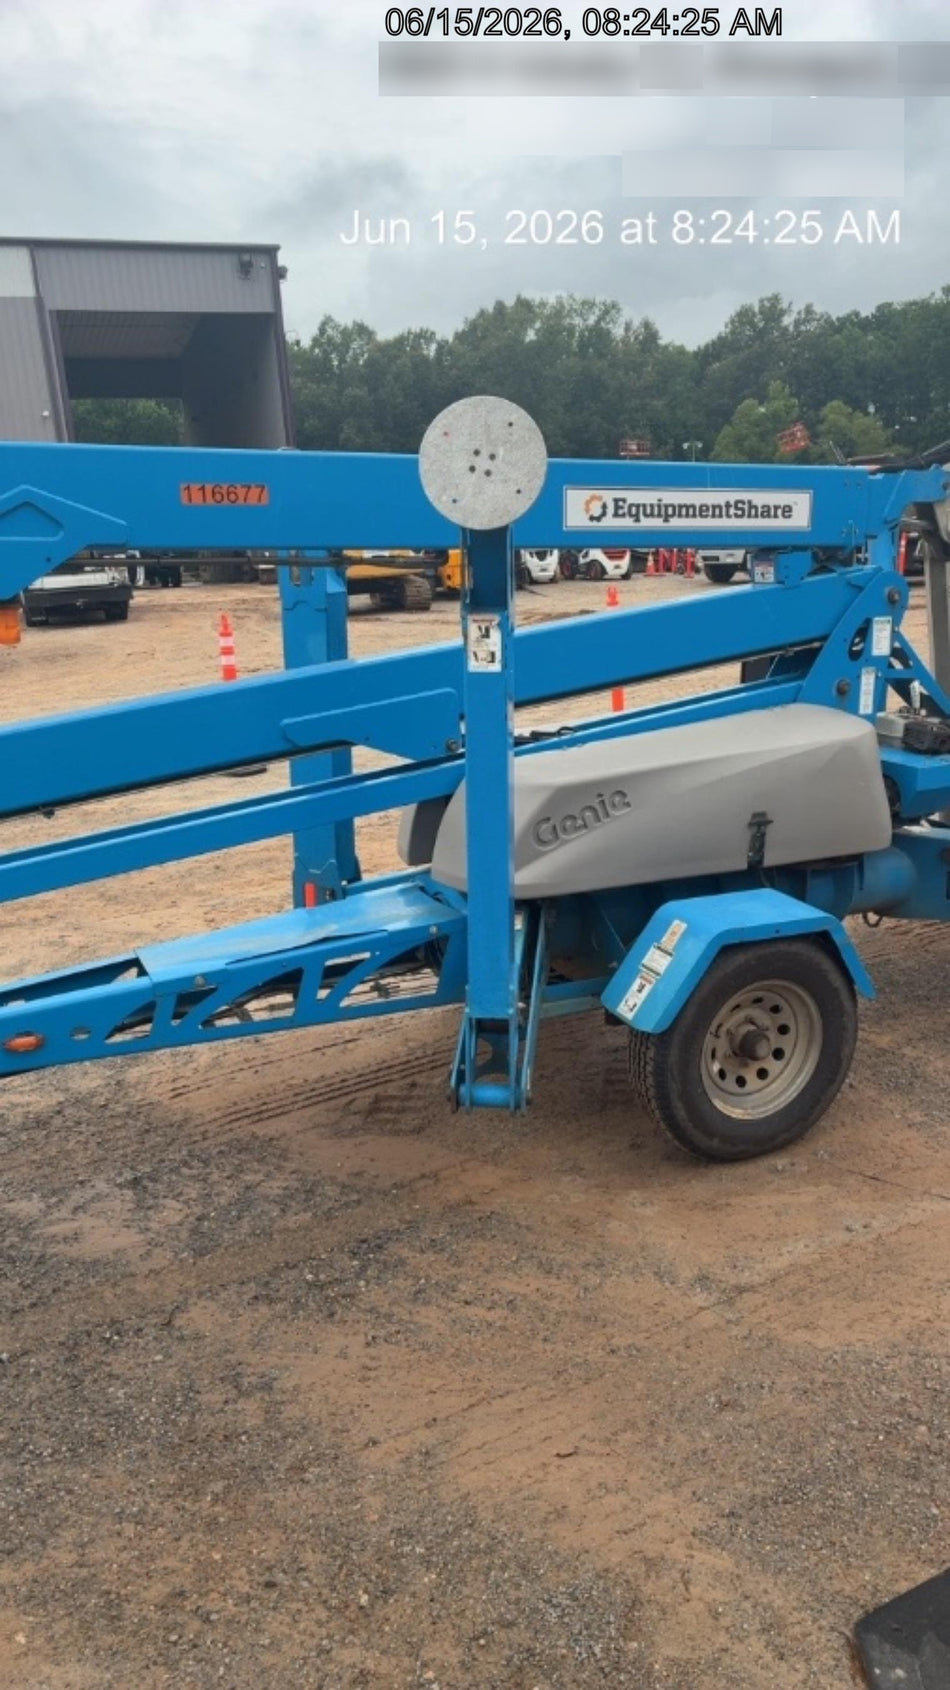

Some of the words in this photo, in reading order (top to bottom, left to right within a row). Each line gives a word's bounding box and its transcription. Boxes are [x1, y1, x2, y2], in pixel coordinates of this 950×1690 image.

[183, 484, 266, 504] 116677
[611, 498, 793, 523] EquipmentShare
[532, 790, 632, 852] Genie
